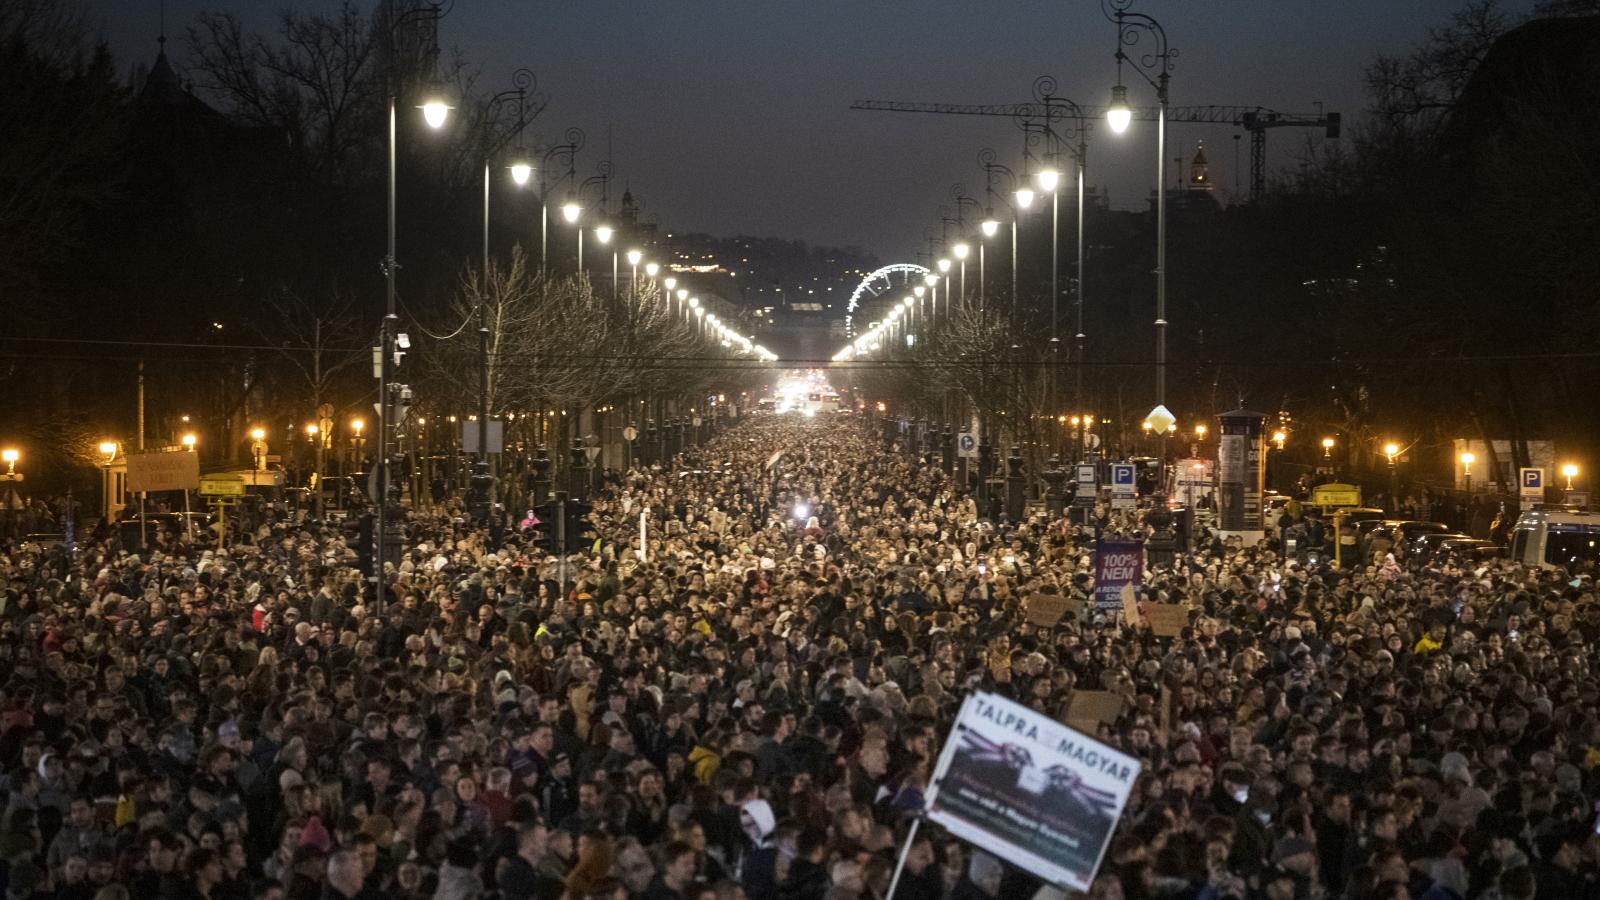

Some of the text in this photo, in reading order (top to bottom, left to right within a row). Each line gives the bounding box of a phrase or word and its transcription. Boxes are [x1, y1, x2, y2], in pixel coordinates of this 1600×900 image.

[1118, 469, 1129, 481] P
[1526, 473, 1538, 485] P
[1104, 554, 1138, 567] 100%
[1102, 568, 1134, 580] NEM
[975, 700, 1039, 741] TALPRA
[1056, 738, 1131, 782] MAGYAR
